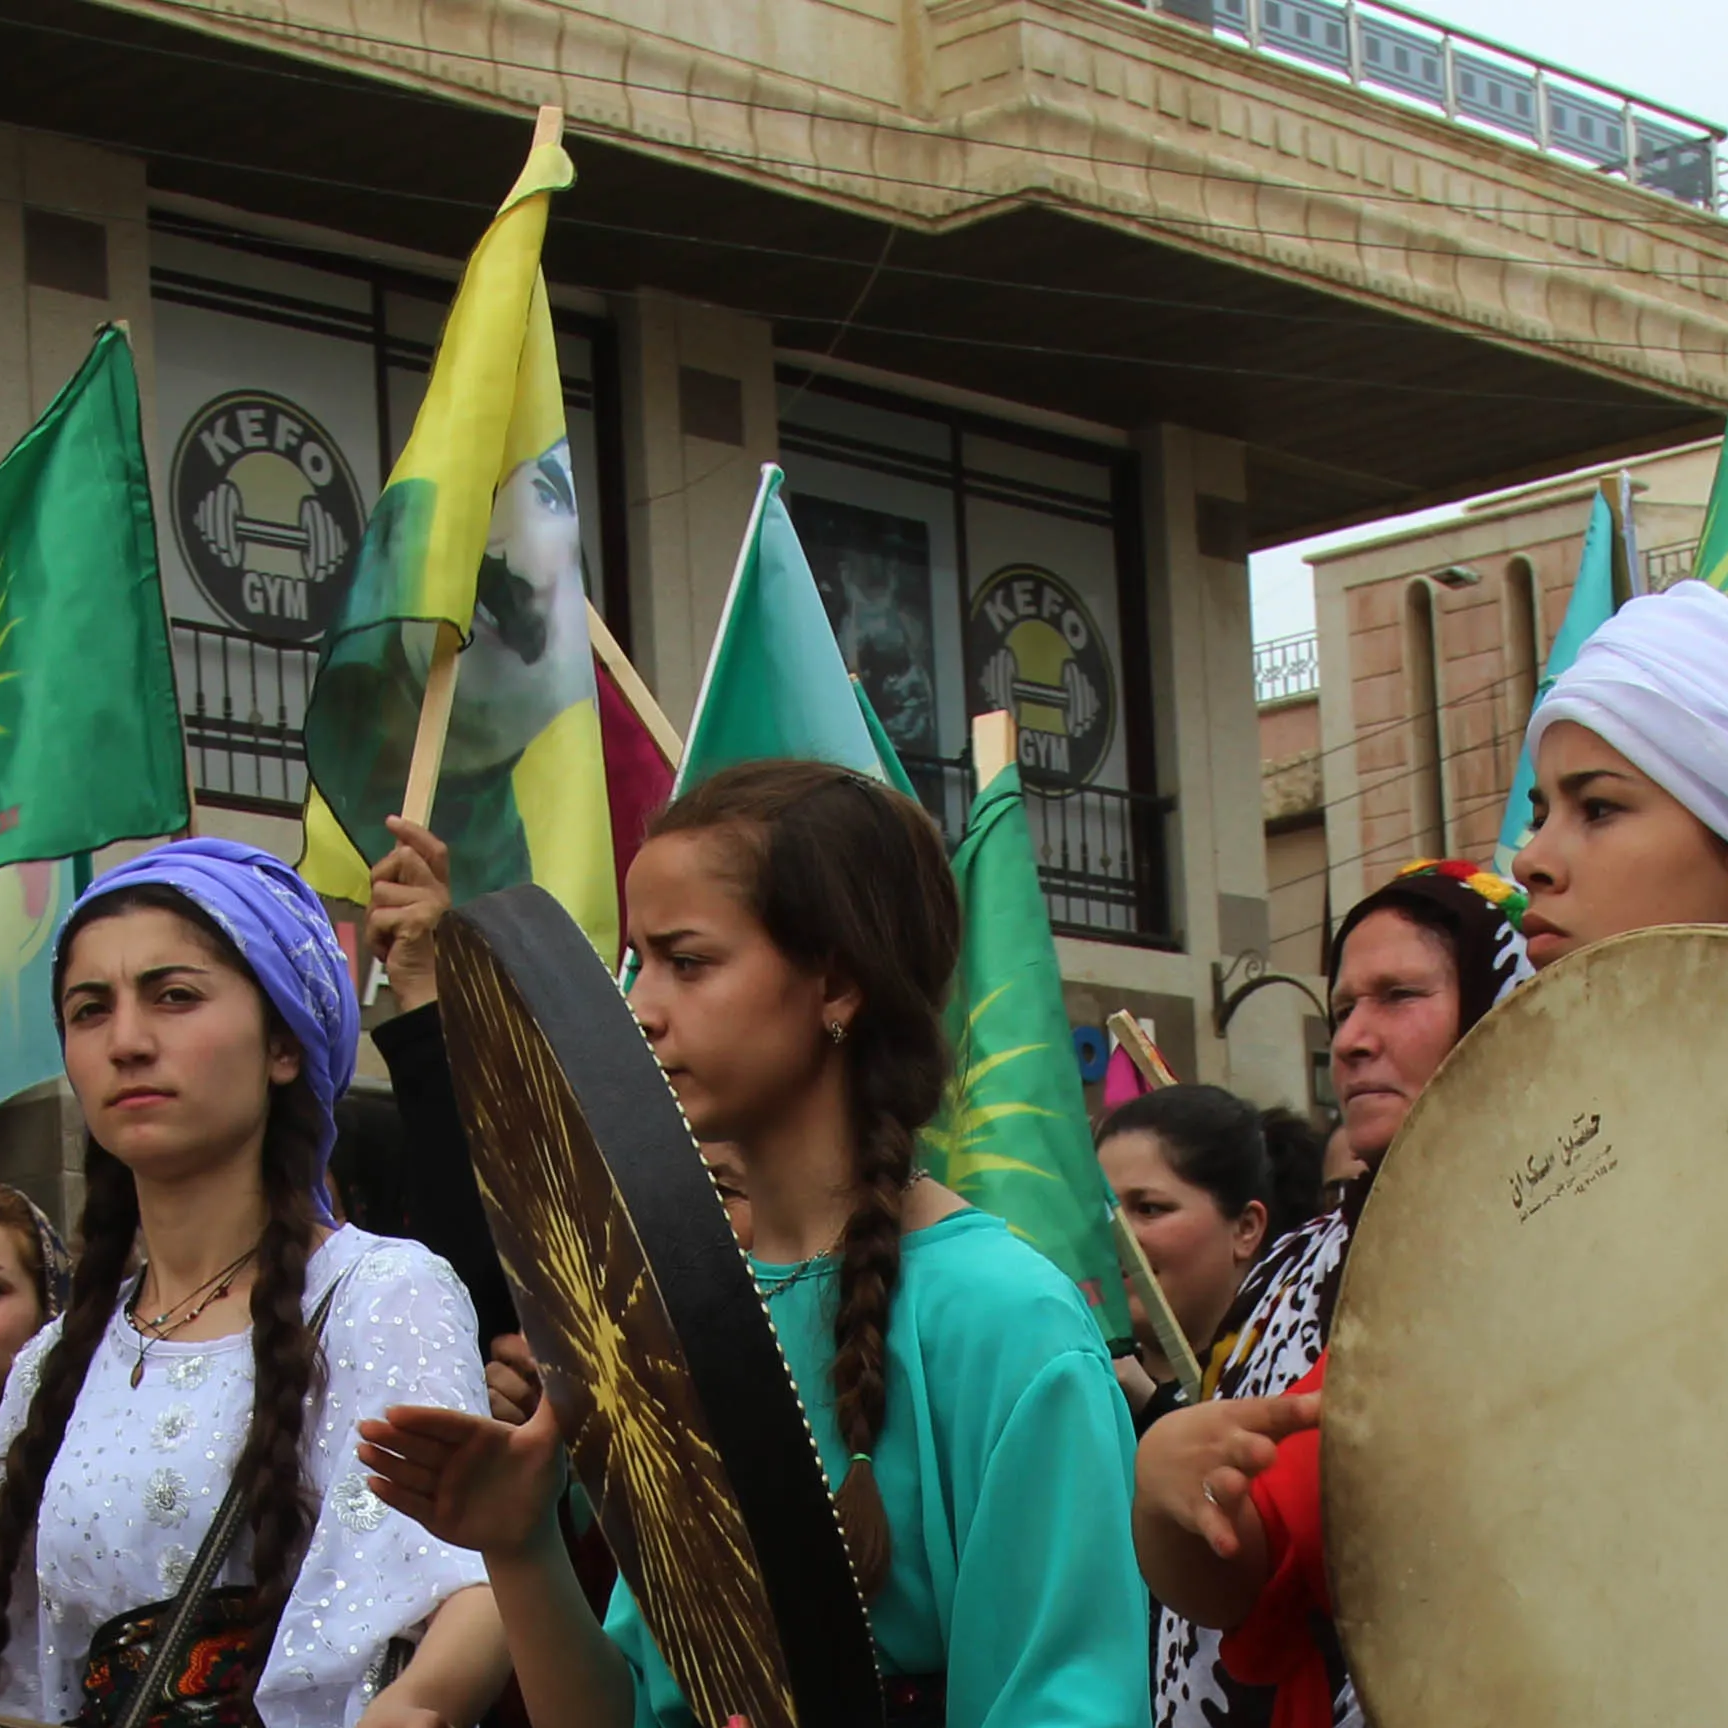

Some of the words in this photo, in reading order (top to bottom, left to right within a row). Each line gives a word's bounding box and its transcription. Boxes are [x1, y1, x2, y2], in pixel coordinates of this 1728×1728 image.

[199, 409, 333, 487] KEFO
[242, 571, 308, 621] GYM
[984, 580, 1088, 650] KEFO
[1018, 730, 1070, 774] GYM
